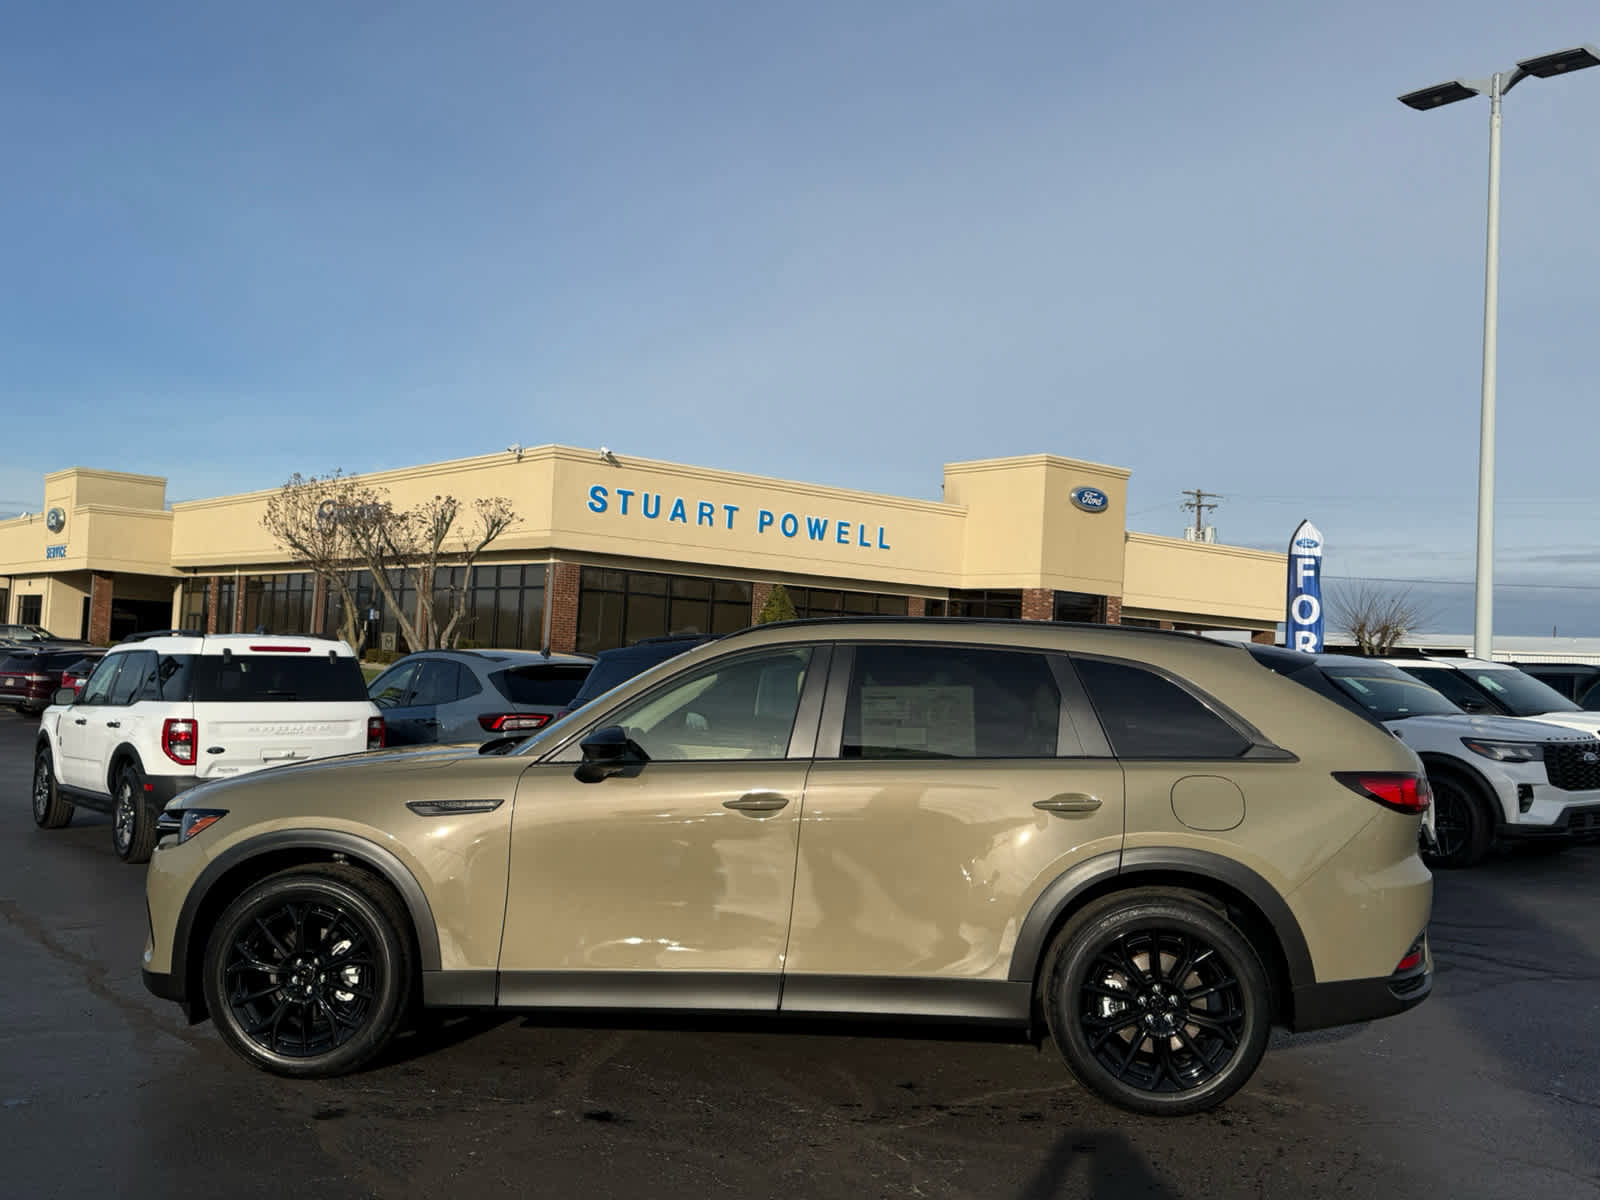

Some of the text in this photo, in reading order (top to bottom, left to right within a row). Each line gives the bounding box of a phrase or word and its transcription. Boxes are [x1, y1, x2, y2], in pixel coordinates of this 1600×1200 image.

[587, 485, 891, 550] STUART POWELL
[1081, 490, 1104, 506] Ford
